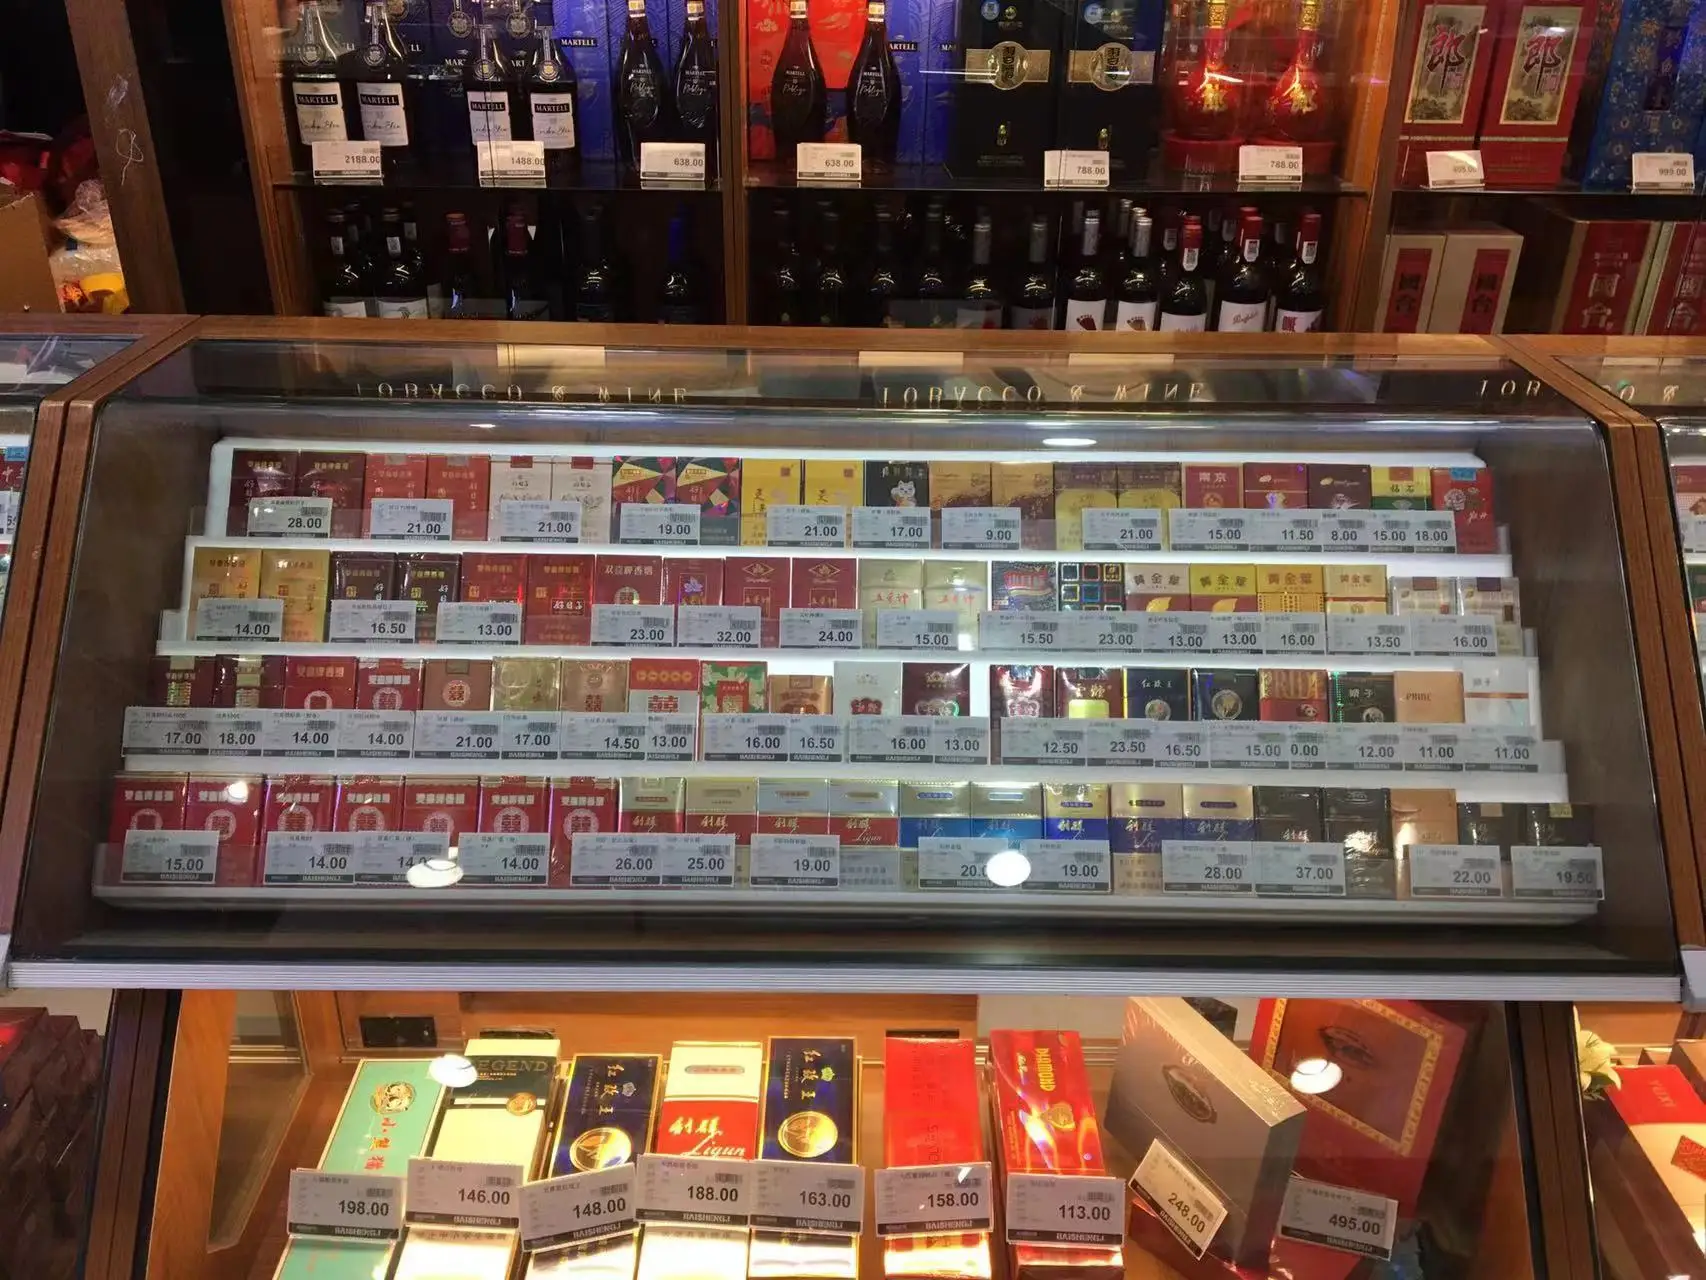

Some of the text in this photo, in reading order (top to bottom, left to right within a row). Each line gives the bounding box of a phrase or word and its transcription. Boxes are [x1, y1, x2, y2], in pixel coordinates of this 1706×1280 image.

[298, 94, 336, 103] MARTELL
[361, 95, 397, 104] MARTELL
[674, 158, 704, 166] 638.00
[825, 159, 854, 167] 638.00
[1270, 161, 1299, 169] 788.00
[1077, 166, 1106, 175] 788.00
[1199, 472, 1227, 482] 南京
[287, 517, 322, 529] 28.00
[407, 523, 441, 534] 21.00
[538, 522, 572, 533] 21.00
[659, 524, 691, 535] 19.00
[804, 526, 838, 536] 21.00
[891, 526, 923, 537] 17.00
[986, 530, 1012, 540] 9.00
[1120, 529, 1153, 539] 21.00
[1208, 529, 1241, 540] 15.00
[1281, 529, 1314, 540] 11.50
[1331, 531, 1358, 541] 8.00
[1373, 531, 1407, 541] 15.00
[1415, 531, 1448, 541] 18.00
[234, 624, 270, 635] 14.00
[370, 623, 406, 634] 16.50
[477, 624, 512, 636] 13.00
[630, 629, 664, 641] 23.00
[716, 631, 751, 642] 32.00
[819, 631, 853, 642] 24.00
[915, 634, 949, 645] 15.00
[1020, 633, 1053, 644] 15.50
[1099, 634, 1133, 645] 23.00
[1168, 636, 1203, 646] 13.00
[1222, 634, 1257, 645] 13.00
[1280, 634, 1315, 645] 16.00
[1367, 636, 1401, 648] 13.50
[1453, 636, 1488, 647] 16.00
[164, 732, 201, 744] 17.00
[219, 732, 256, 745] 18.00
[292, 732, 329, 744] 14.00
[368, 733, 403, 745] 14.00
[456, 736, 493, 748] 21.00
[514, 734, 551, 746] 17.00
[604, 736, 640, 749] 14.50
[652, 735, 687, 748] 13.00
[745, 736, 781, 748] 16.00
[800, 737, 835, 749] 16.50
[890, 738, 926, 750] 16.00
[944, 739, 979, 751] 13.00
[1043, 742, 1078, 754] 12.50
[1110, 741, 1146, 752] 23.50
[1165, 744, 1201, 756] 16.50
[1245, 745, 1281, 756] 15.00
[1359, 746, 1395, 757] 12.00
[1419, 747, 1454, 758] 11.00
[1494, 747, 1530, 759] 11.00
[165, 858, 204, 871] 15.00
[309, 856, 347, 869] 14.00
[501, 857, 539, 870] 14.00
[615, 857, 653, 871] 26.00
[687, 857, 725, 871] 25.00
[793, 859, 831, 872] 19.00
[960, 864, 988, 877] 20.0
[1062, 864, 1098, 877] 19.00
[1204, 867, 1242, 880] 28.00
[1296, 867, 1333, 880] 37.00
[1453, 870, 1491, 884] 22.00
[477, 1059, 549, 1072] EGEND
[1035, 1048, 1056, 1091] DIAMOND
[458, 1188, 510, 1205] 146.00
[687, 1185, 738, 1202] 188.00
[799, 1191, 851, 1208] 163.00
[927, 1192, 979, 1208] 158.00
[338, 1200, 389, 1217] 198.00
[572, 1197, 626, 1219] 148.00
[1058, 1204, 1110, 1221] 113.00
[1168, 1192, 1205, 1234] 248.00
[1329, 1213, 1380, 1236] 495.00
